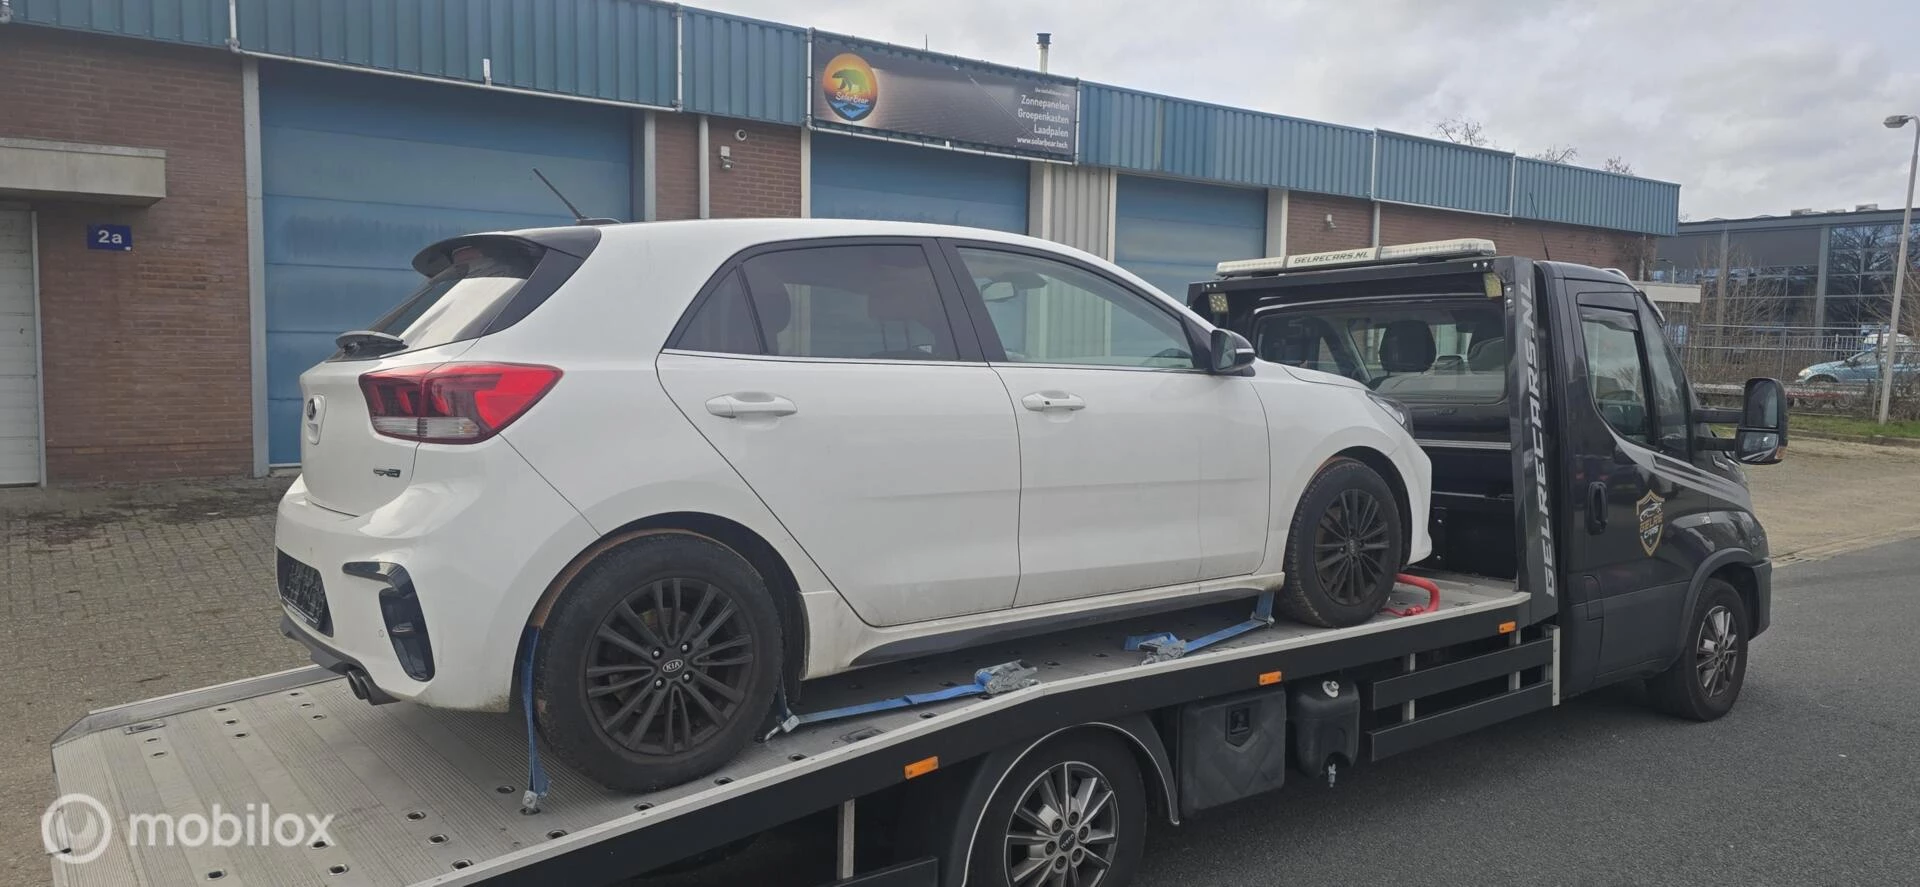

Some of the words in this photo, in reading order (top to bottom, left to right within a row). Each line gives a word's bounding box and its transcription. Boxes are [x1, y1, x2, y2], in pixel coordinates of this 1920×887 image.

[1021, 94, 1070, 110] Zonnepanelen
[1017, 108, 1070, 124] Groepenkasten
[1033, 123, 1069, 138] Laadpalen
[98, 230, 122, 244] 2a
[1294, 251, 1369, 264] GELRECARS.NL
[1520, 277, 1555, 598] GELRECARS.NL
